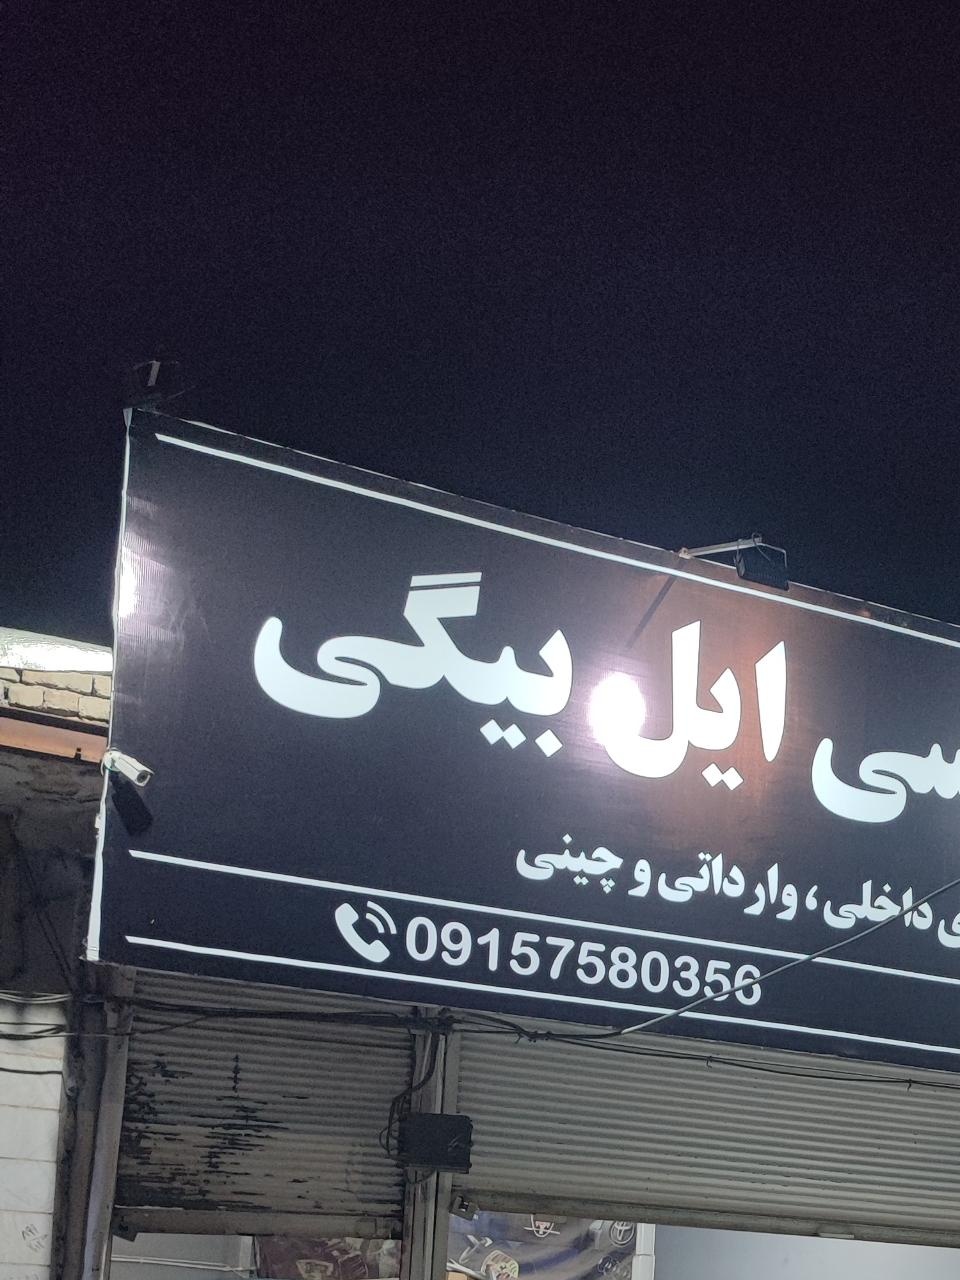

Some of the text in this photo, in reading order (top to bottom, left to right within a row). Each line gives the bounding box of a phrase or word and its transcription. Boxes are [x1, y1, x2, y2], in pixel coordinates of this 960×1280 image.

[253, 571, 574, 758] بیگی
[590, 619, 787, 792] ایل
[516, 833, 624, 894] چینی
[627, 858, 652, 898] و
[657, 851, 798, 920] وارداتی
[405, 916, 763, 1005] 09157580356
